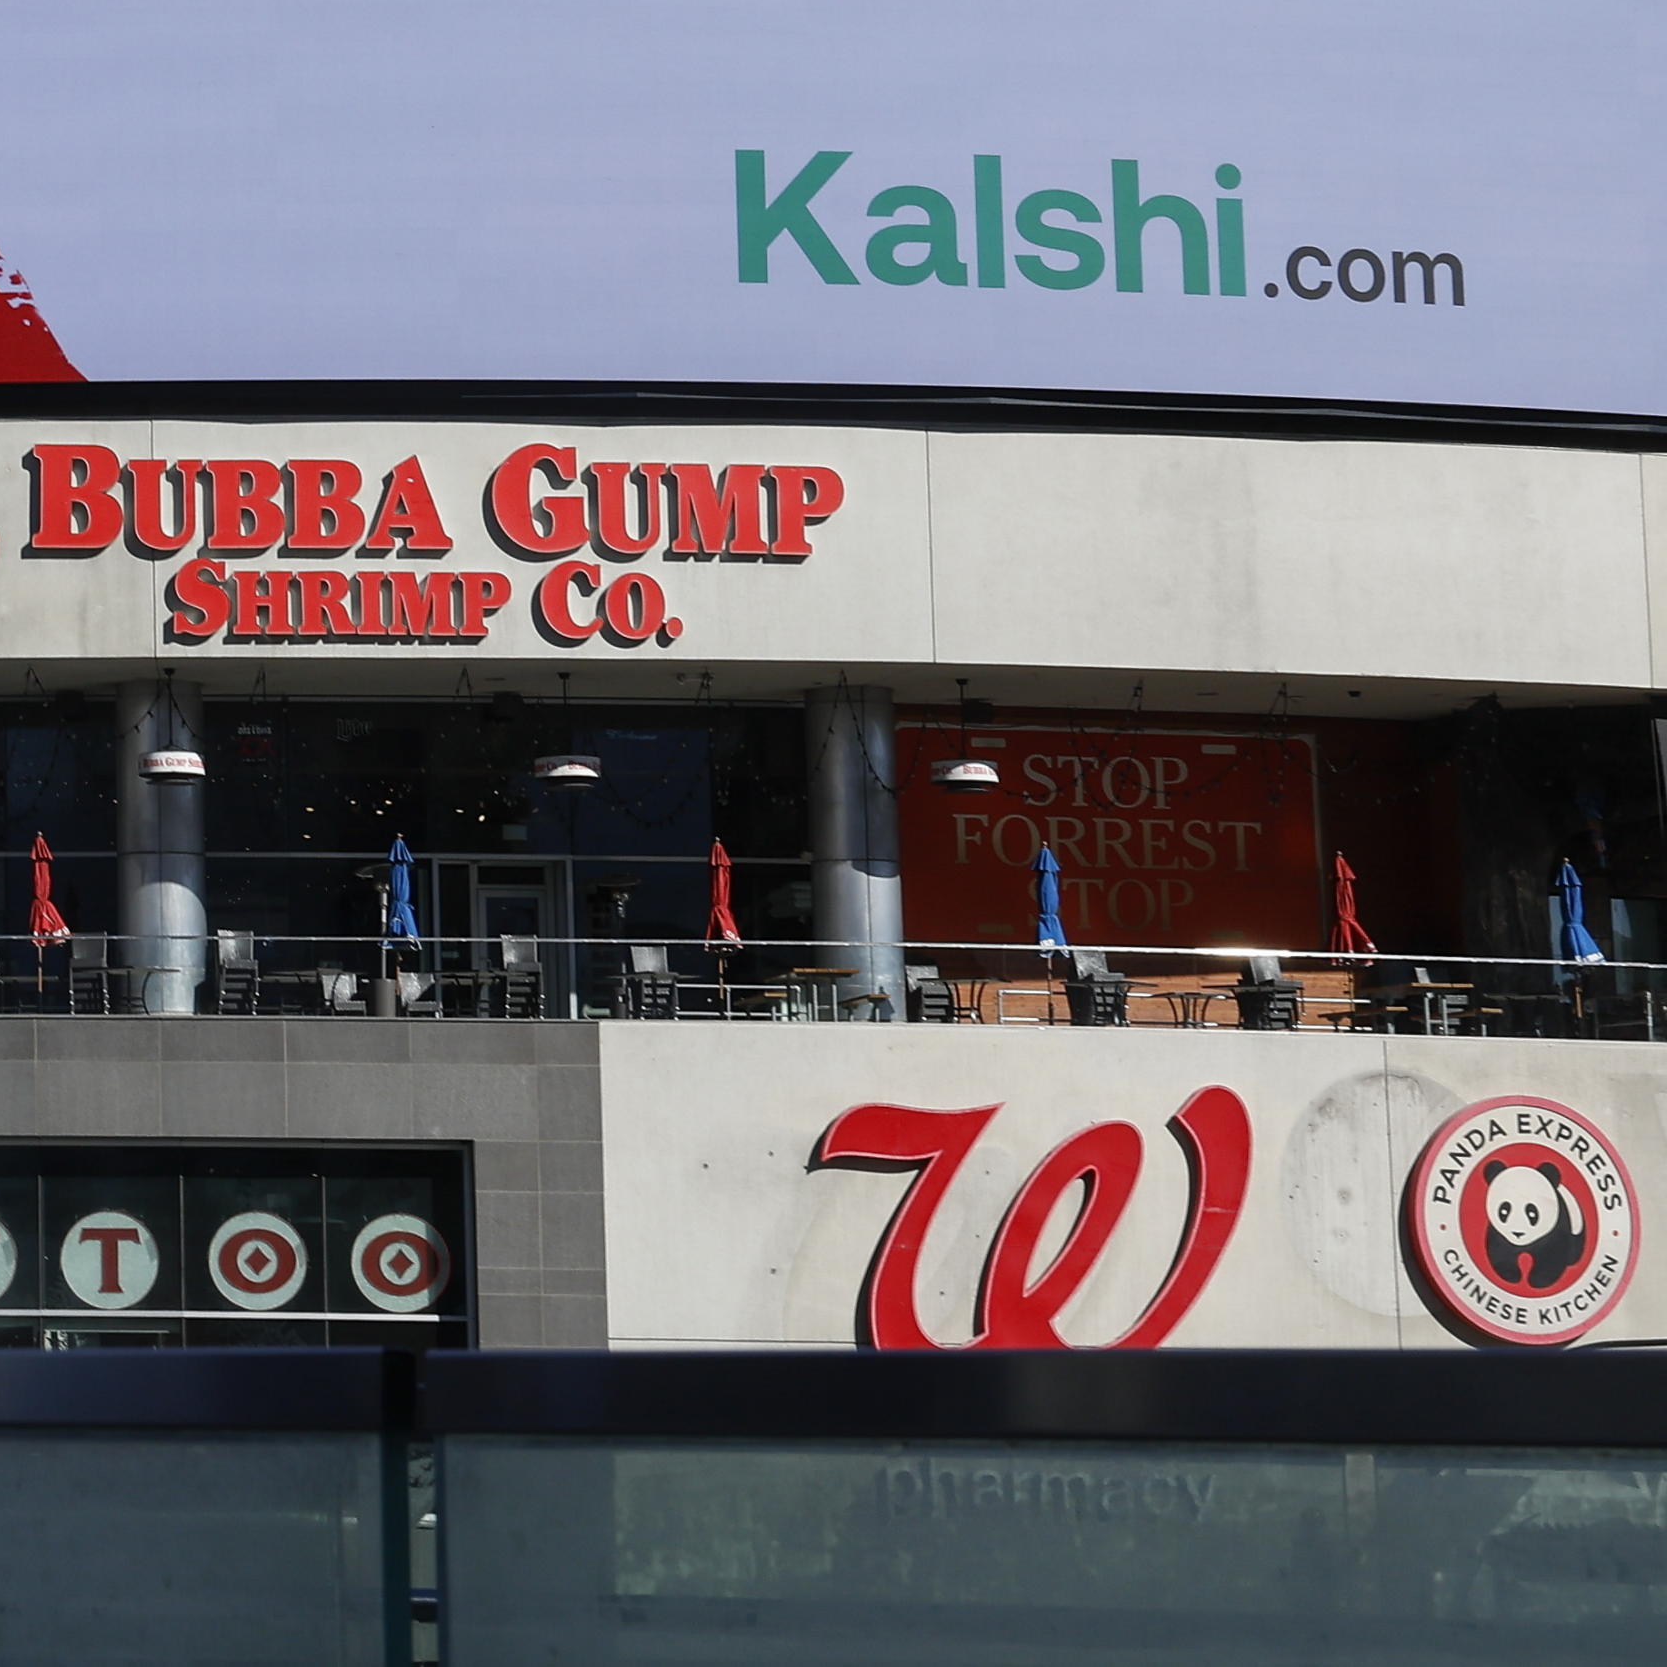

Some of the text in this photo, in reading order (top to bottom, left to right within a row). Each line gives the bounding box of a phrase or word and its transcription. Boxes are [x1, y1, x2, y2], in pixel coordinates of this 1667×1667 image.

[733, 149, 1467, 307] Kalshi.com
[32, 443, 845, 556] BUBBA GUMP
[174, 558, 511, 638] SHRIMP
[1022, 753, 1190, 811] STOP
[952, 813, 1263, 872] FORREST
[1433, 1113, 1623, 1211] PANDA EXPRESS
[1443, 1249, 1619, 1325] CHINESE KITCHEN
[875, 1456, 1217, 1526] pharmacy
